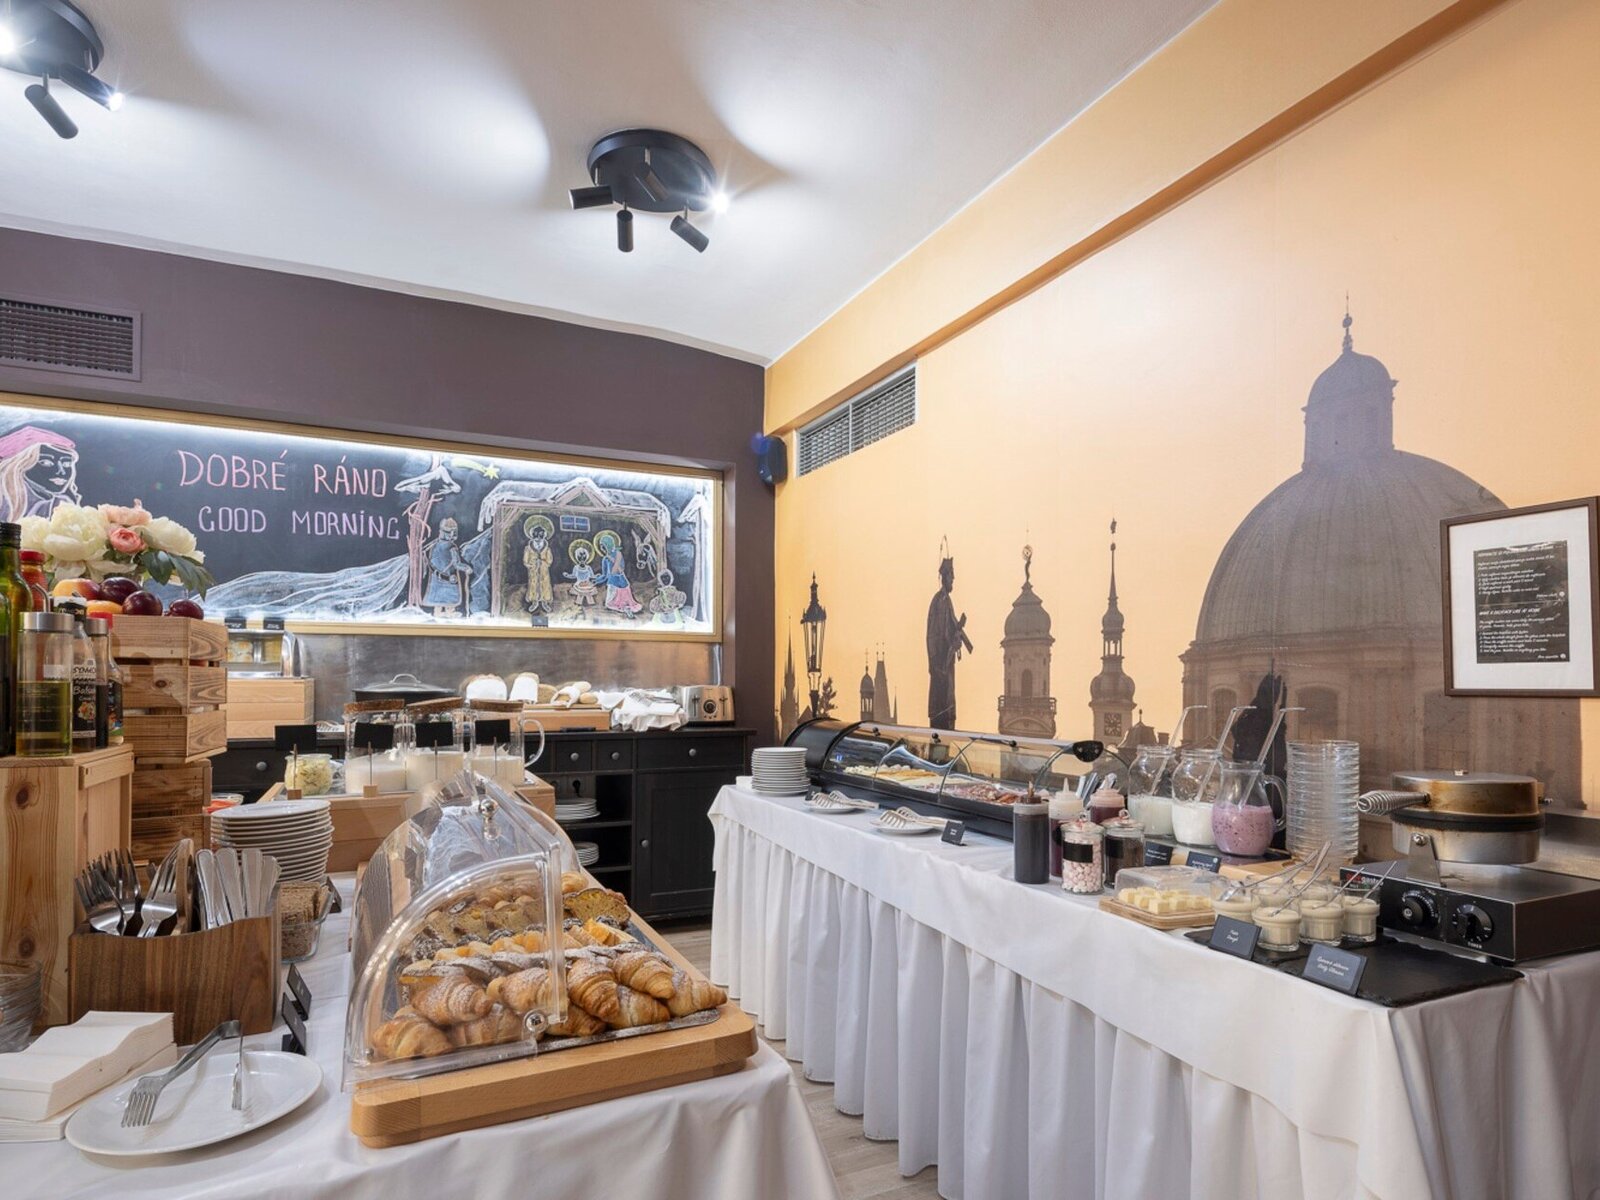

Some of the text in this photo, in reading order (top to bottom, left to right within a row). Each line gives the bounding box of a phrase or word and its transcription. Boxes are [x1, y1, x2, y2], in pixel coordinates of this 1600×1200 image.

[178, 449, 387, 498] DOBRÉ RÁNO
[198, 506, 267, 533] GOOD
